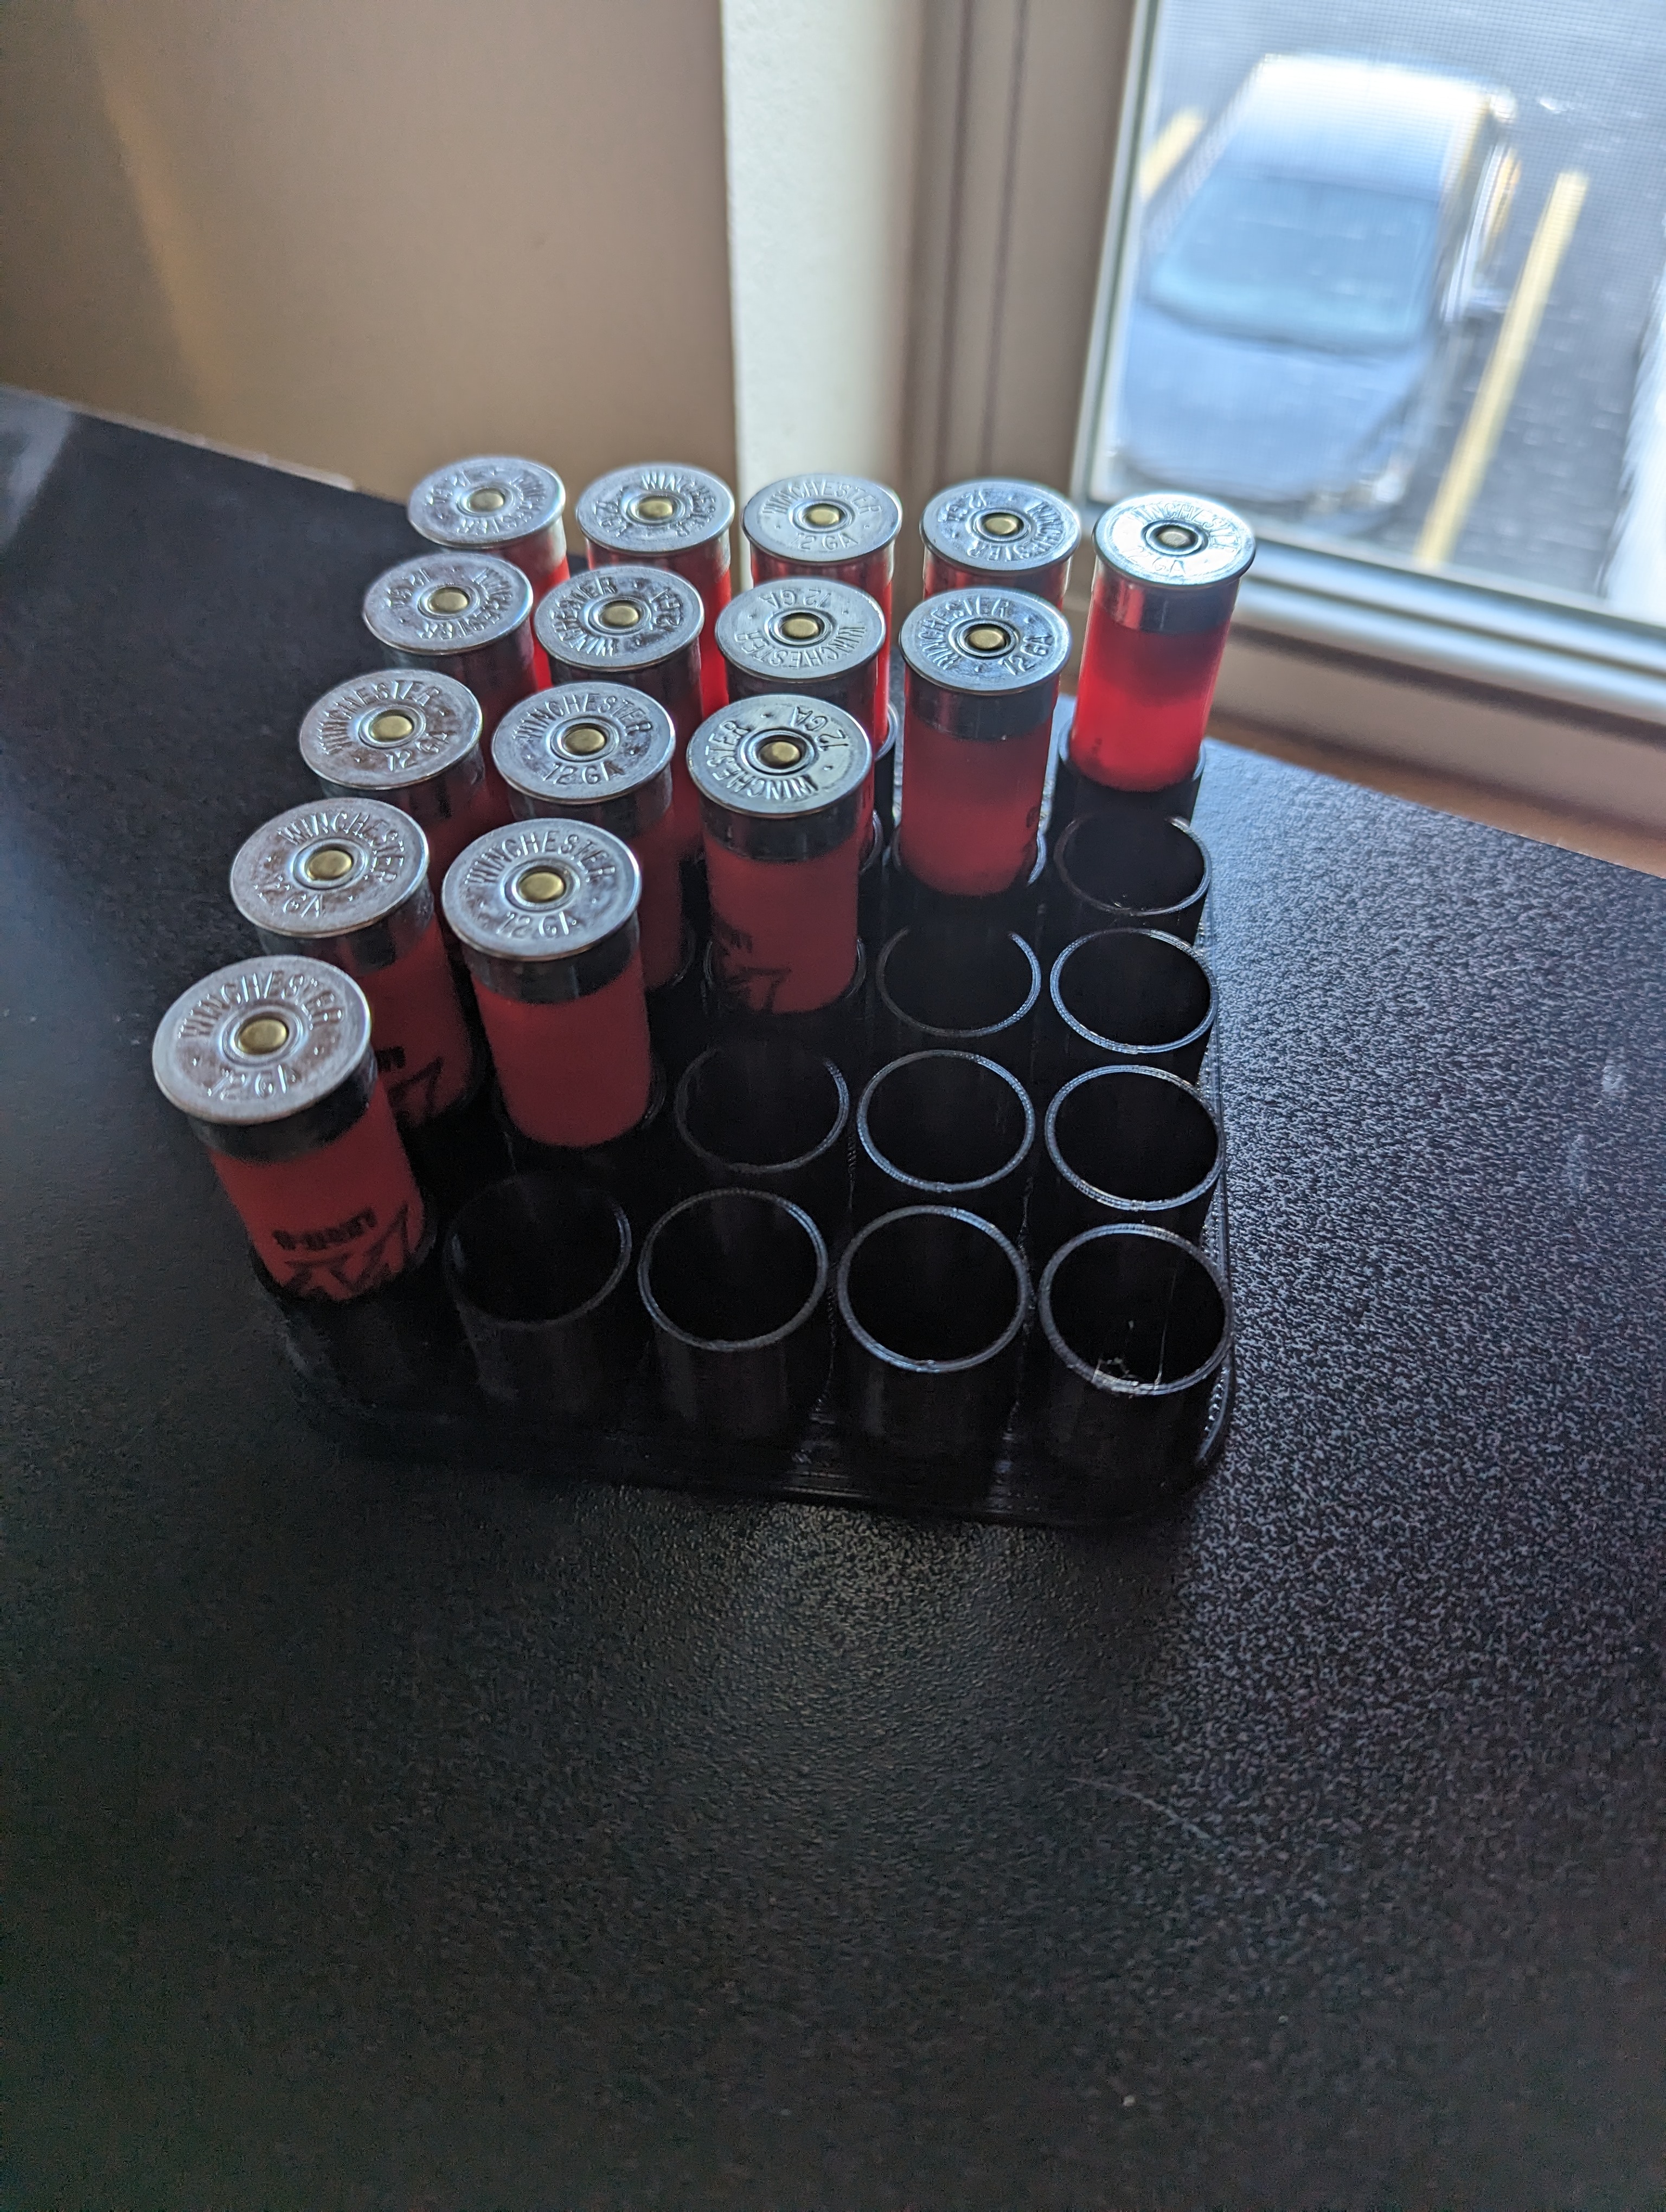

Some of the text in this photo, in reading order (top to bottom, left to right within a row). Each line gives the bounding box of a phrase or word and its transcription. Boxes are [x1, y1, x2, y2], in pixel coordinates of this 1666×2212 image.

[761, 477, 883, 516] WINCHESTER
[790, 532, 859, 551] 12 GA
[1151, 556, 1186, 575] GA
[760, 588, 832, 609] 12 GA
[734, 626, 866, 670] WINCHESTER
[918, 596, 1010, 671] WINCHESTER
[998, 634, 1052, 676] 12 GA
[512, 693, 653, 739] WINCHESTER
[790, 705, 849, 752] 12 GA
[385, 751, 416, 772] 12
[542, 761, 625, 786] 12 GA
[705, 720, 818, 800] WINCHESTER
[464, 830, 616, 885] WINCHESTER
